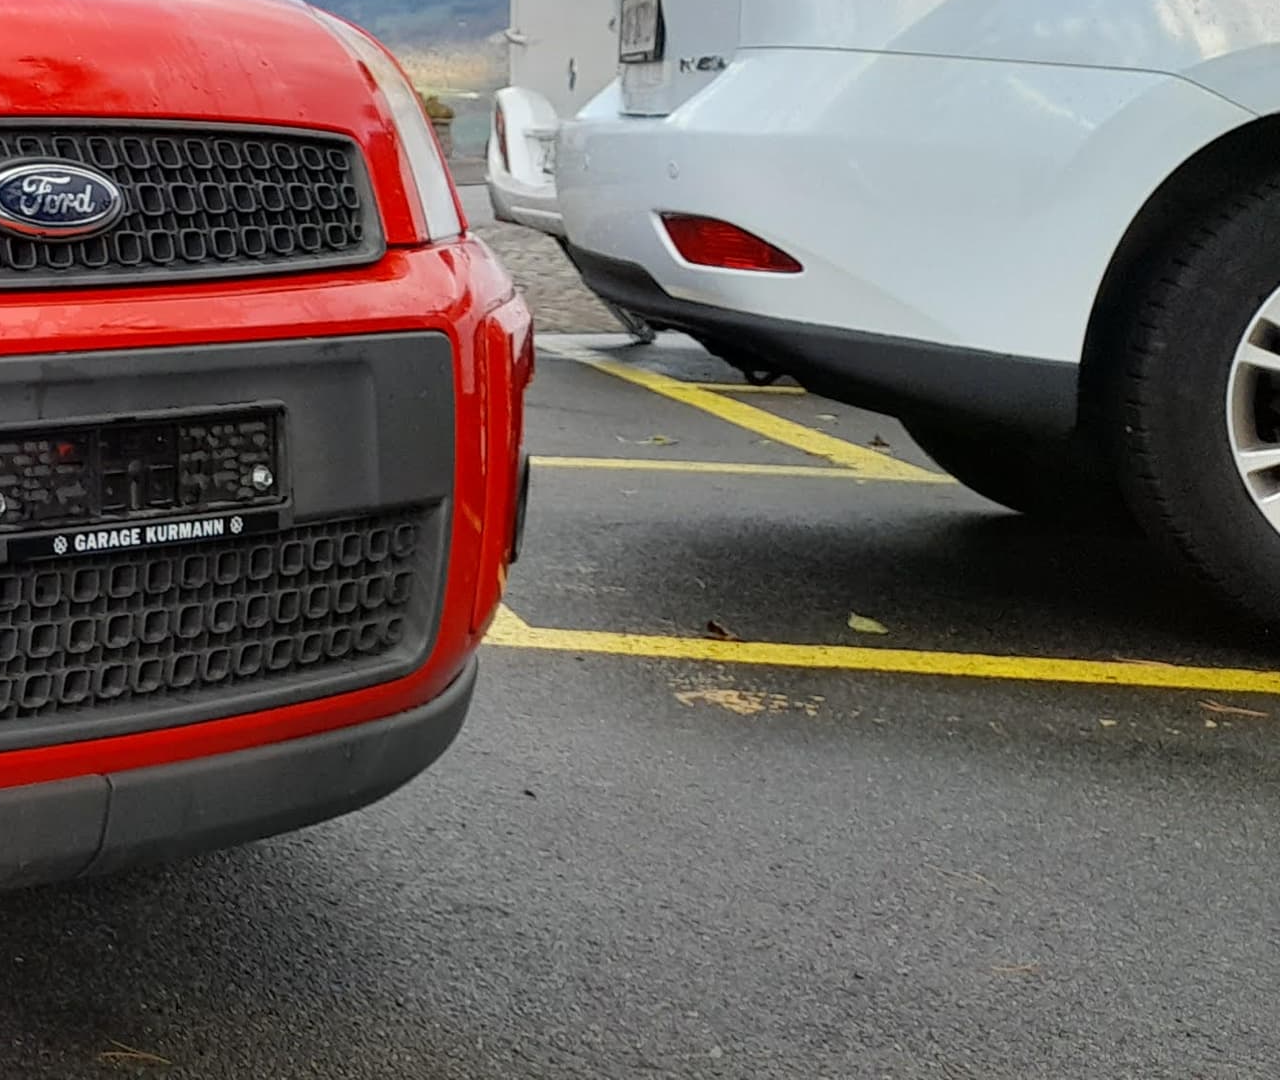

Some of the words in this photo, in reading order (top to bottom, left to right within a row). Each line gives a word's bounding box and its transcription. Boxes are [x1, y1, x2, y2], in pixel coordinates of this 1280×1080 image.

[19, 175, 95, 216] Ford
[74, 528, 141, 551] GARAGE
[145, 519, 224, 543] KURMANN
